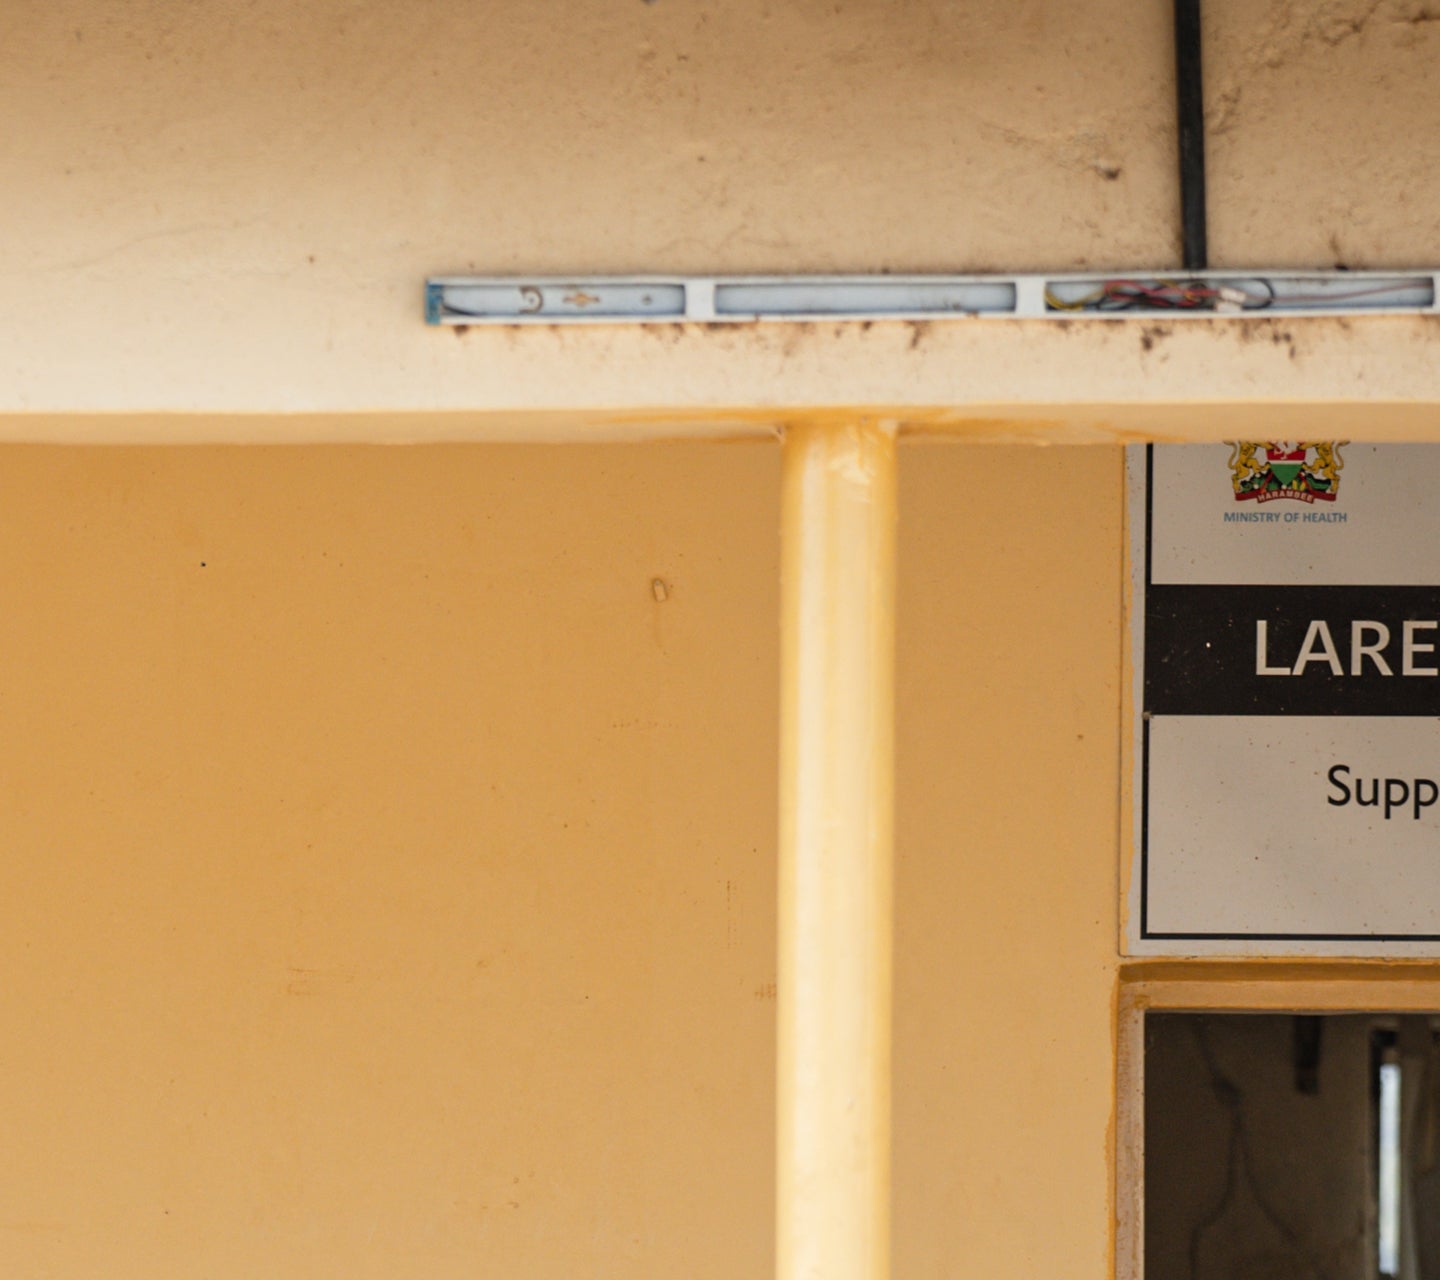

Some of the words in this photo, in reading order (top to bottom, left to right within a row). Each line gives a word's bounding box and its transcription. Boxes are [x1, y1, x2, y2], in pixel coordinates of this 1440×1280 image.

[1224, 512, 1280, 523] MINISTRY
[1284, 512, 1299, 522] OF
[1302, 512, 1347, 522] HEALTH
